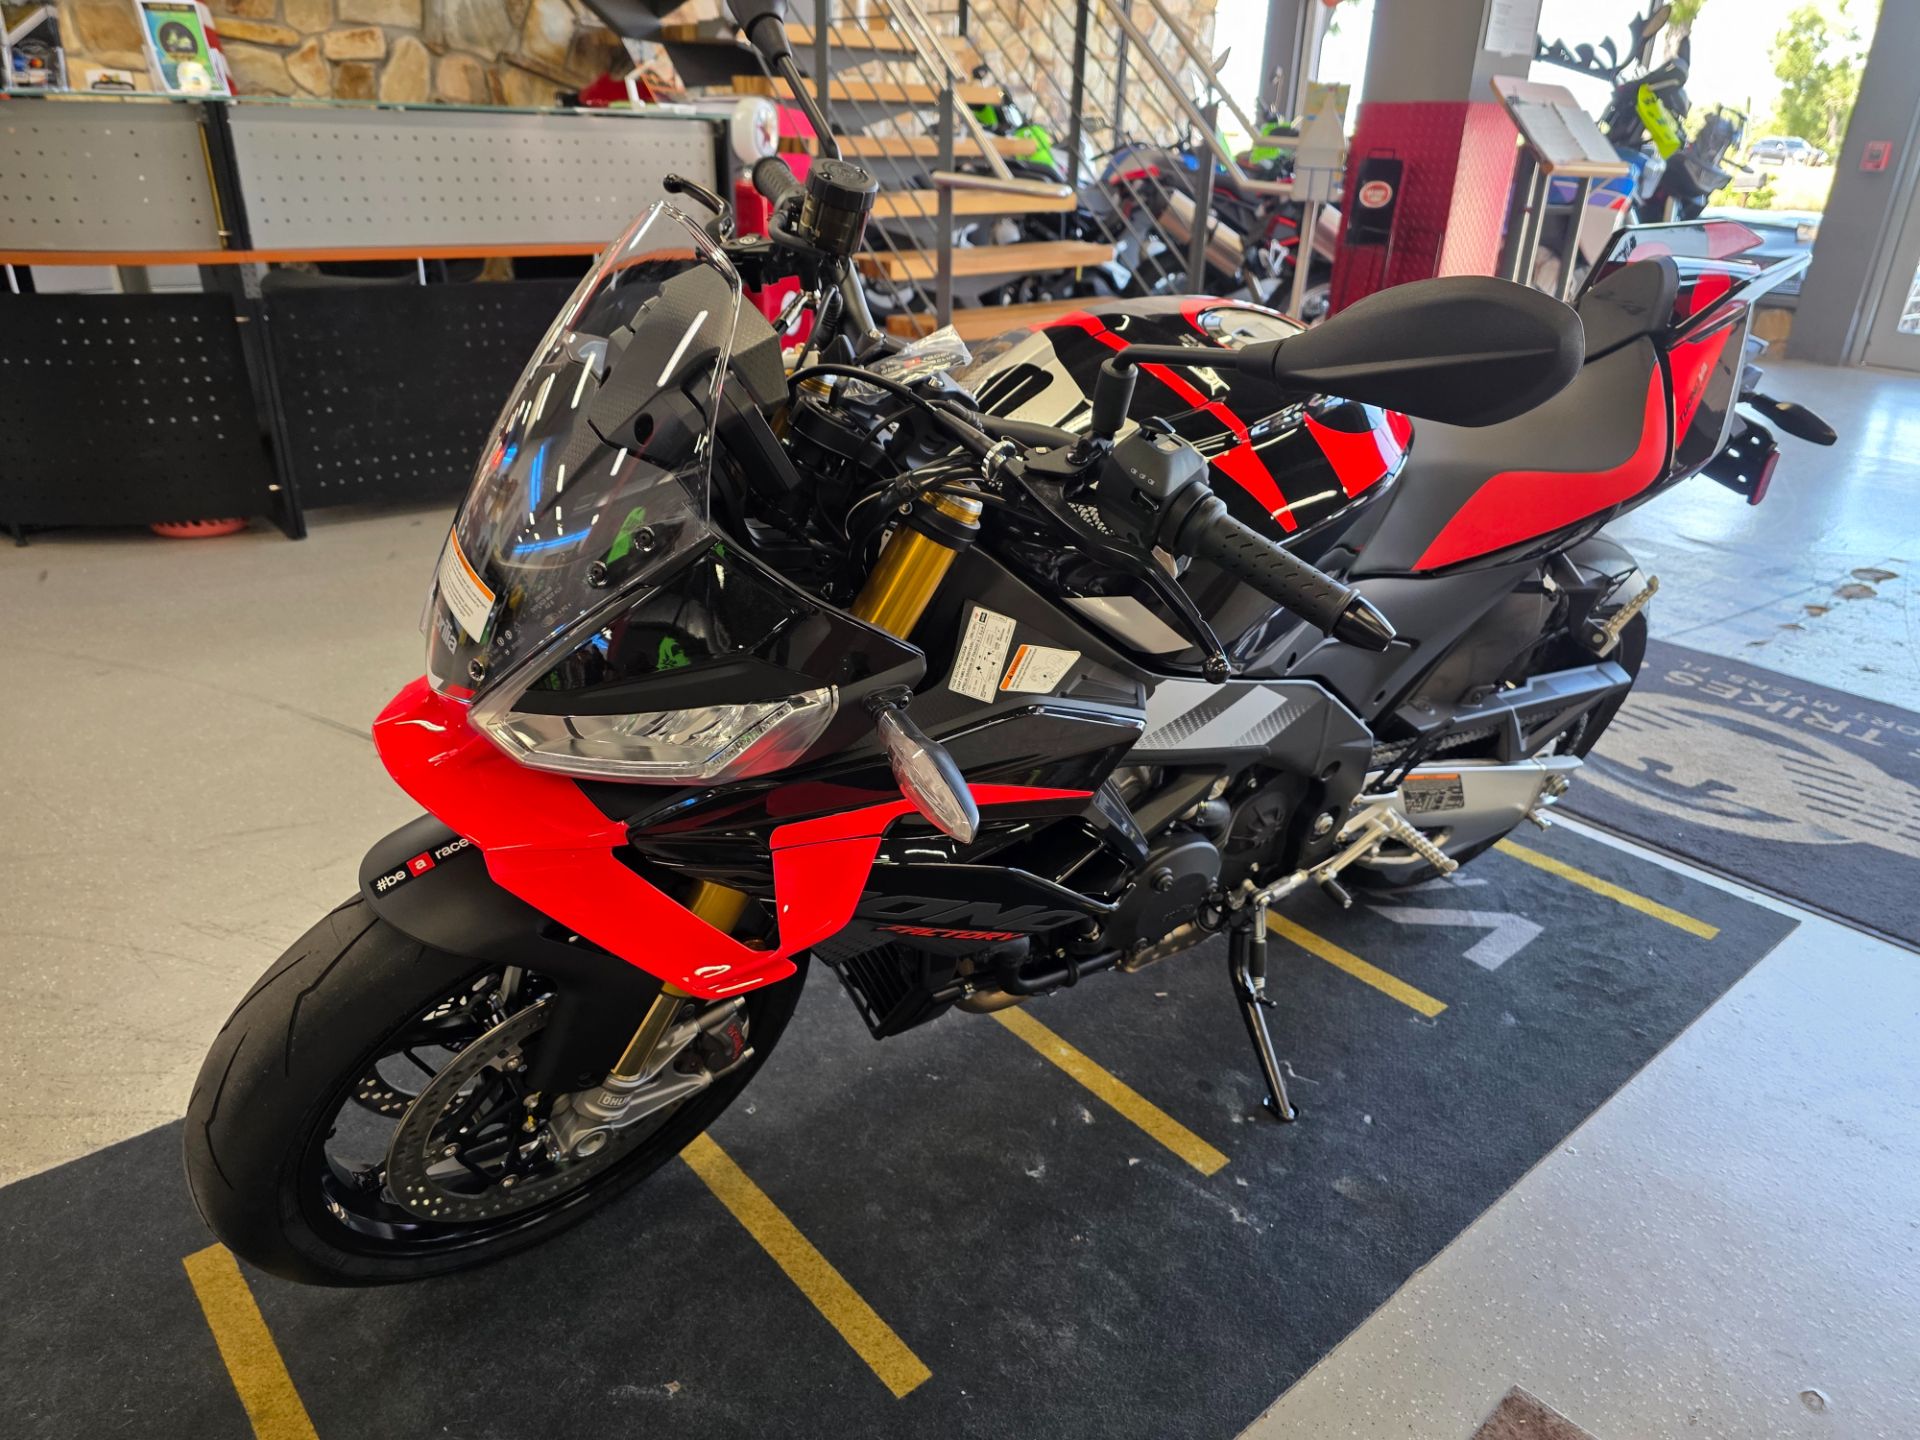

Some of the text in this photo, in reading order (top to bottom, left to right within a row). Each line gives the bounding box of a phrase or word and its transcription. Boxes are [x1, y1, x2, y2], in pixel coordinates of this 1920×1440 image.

[1663, 670, 1888, 747] TRIKES
[1846, 712, 1920, 738] ORT
[376, 838, 470, 892] #be a race
[876, 924, 1026, 942] FACTORY
